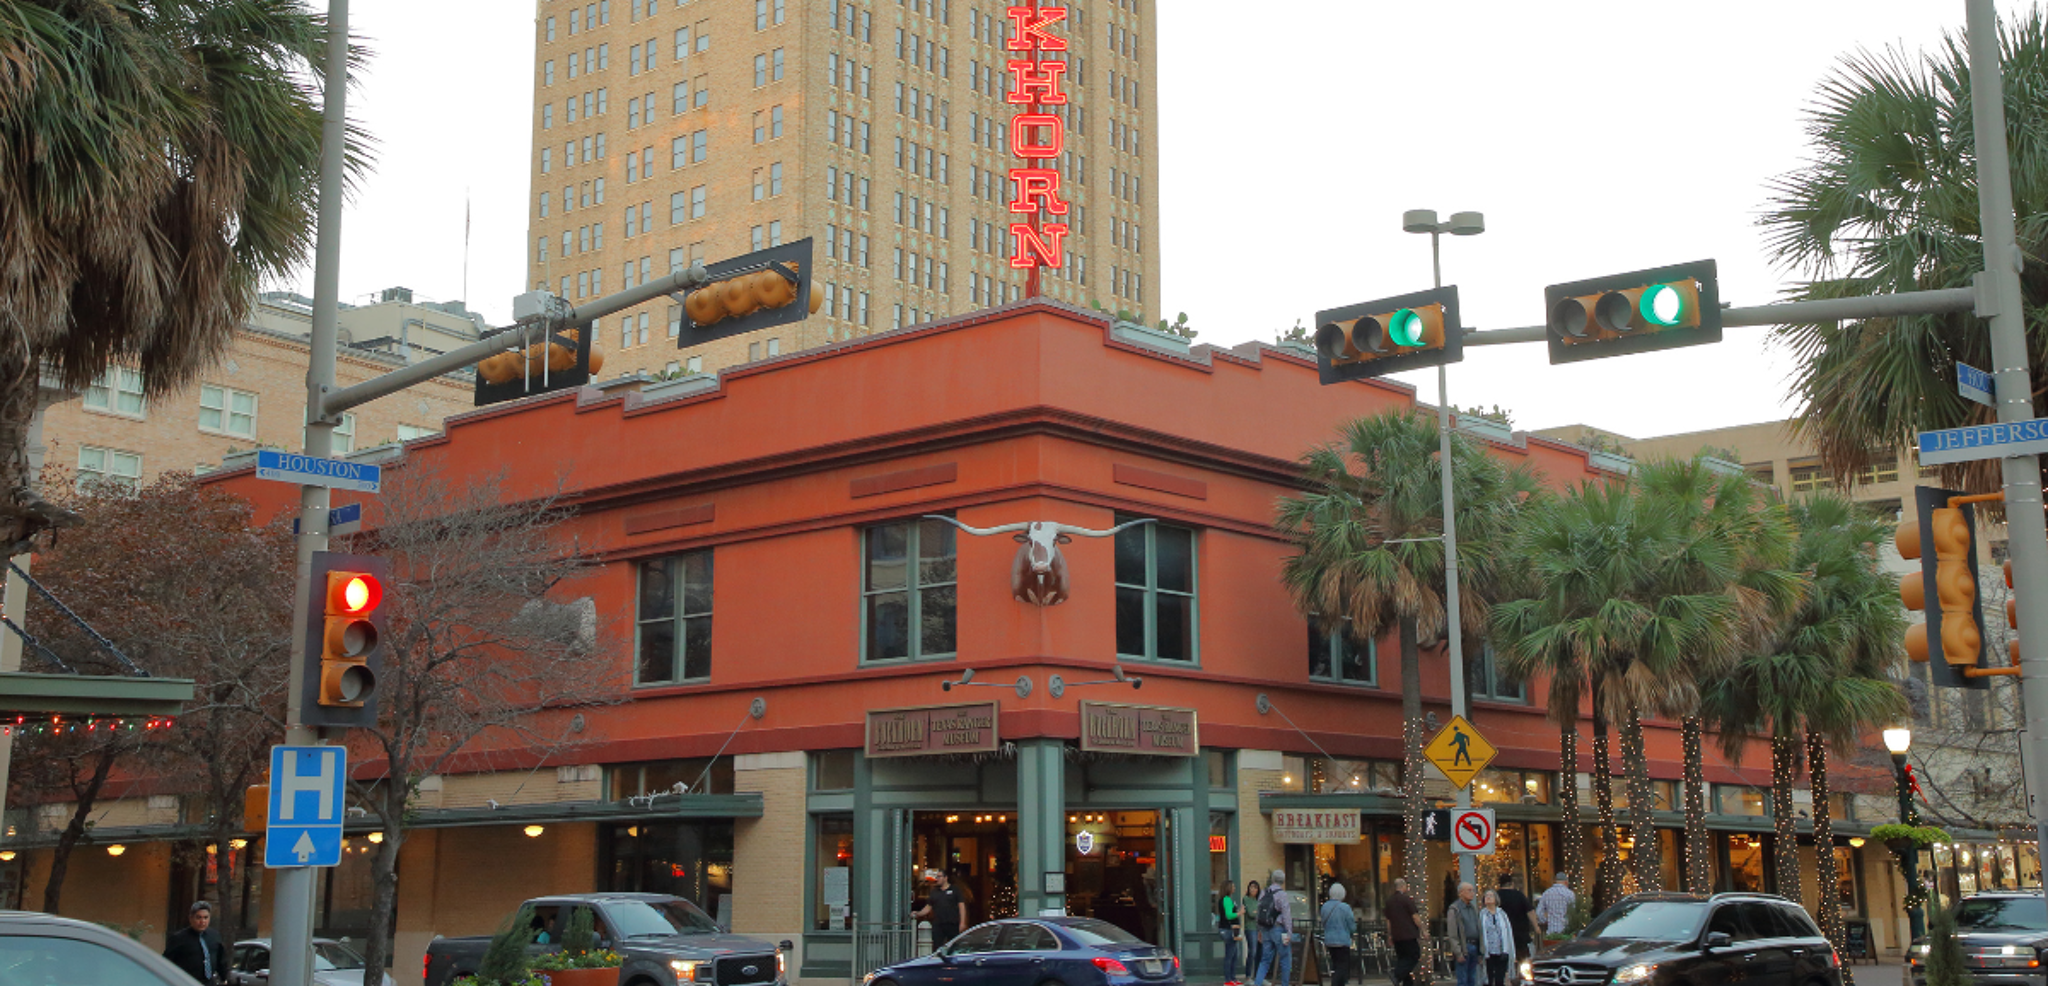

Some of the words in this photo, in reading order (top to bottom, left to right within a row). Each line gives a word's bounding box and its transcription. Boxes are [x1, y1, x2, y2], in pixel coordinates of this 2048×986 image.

[1007, 6, 1068, 269] KHORN
[278, 454, 361, 479] HOUSTON
[932, 719, 957, 732] TEXAS
[957, 716, 992, 730] RANGER
[943, 731, 980, 746] MUSEUM
[1152, 735, 1183, 749] MUSEUM
[279, 750, 335, 820] H
[1276, 813, 1357, 827] BREAKFAST
